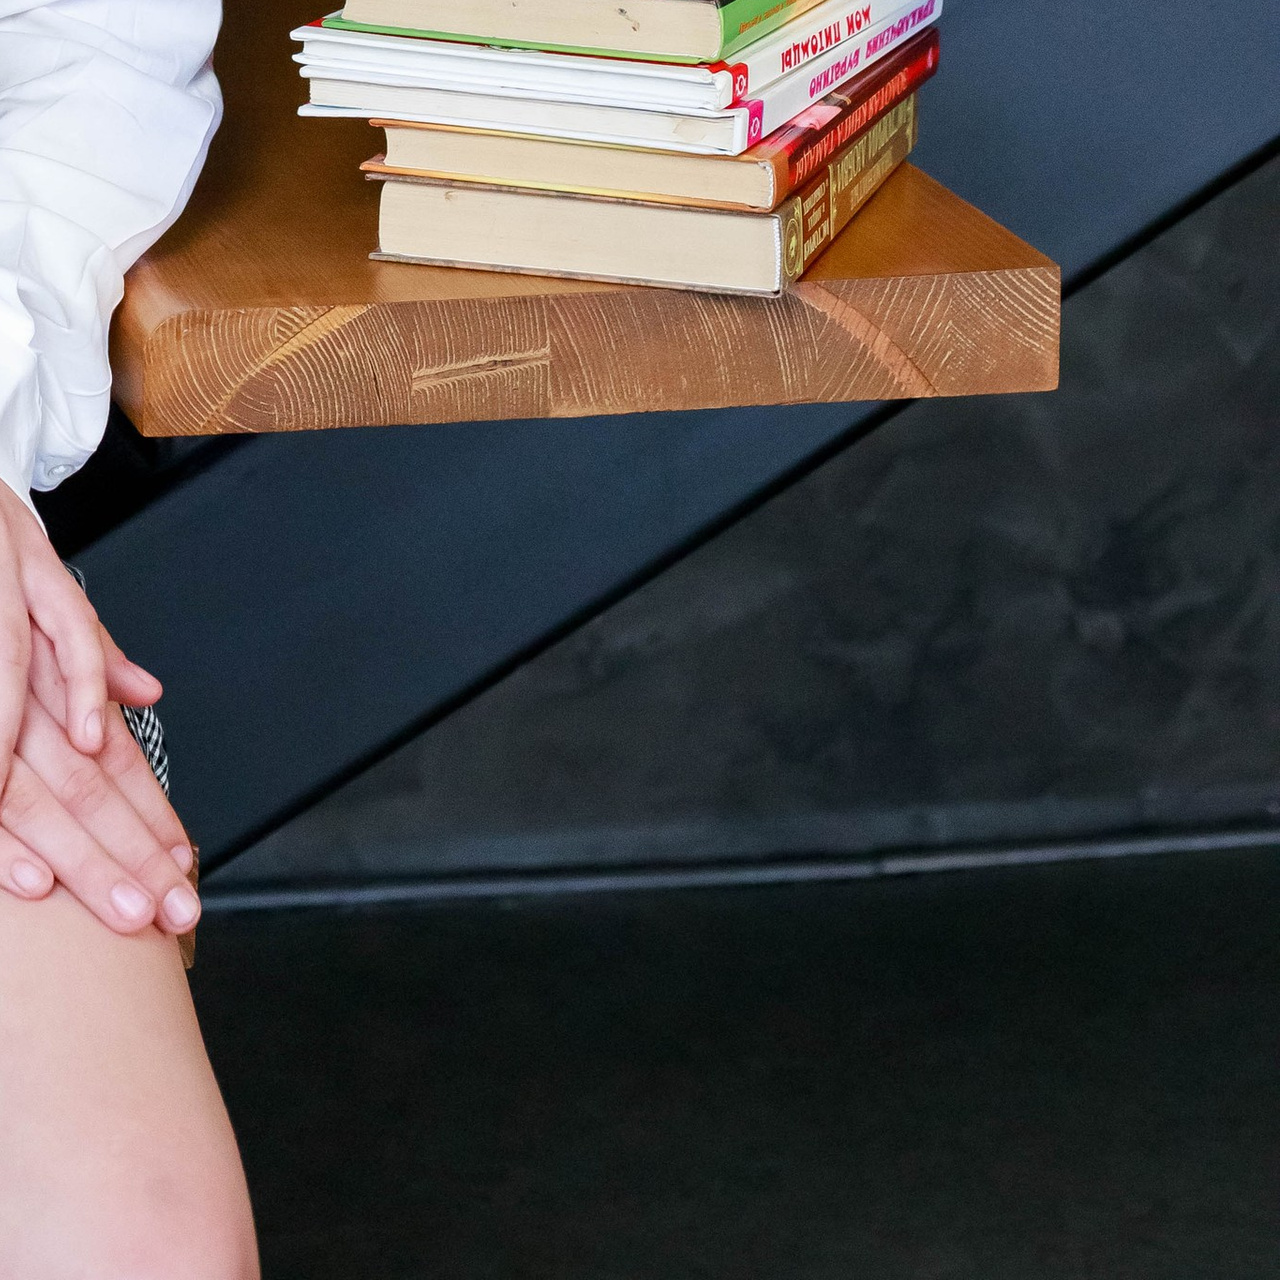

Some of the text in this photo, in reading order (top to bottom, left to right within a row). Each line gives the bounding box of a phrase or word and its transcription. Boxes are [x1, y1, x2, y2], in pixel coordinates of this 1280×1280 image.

[846, 4, 871, 34] МОИ
[781, 20, 840, 73] ПИТОМЦЫ
[809, 47, 861, 99] БУРАТИНО
[837, 103, 866, 146] КНИГА
[795, 129, 835, 185] ТАМАДЫ
